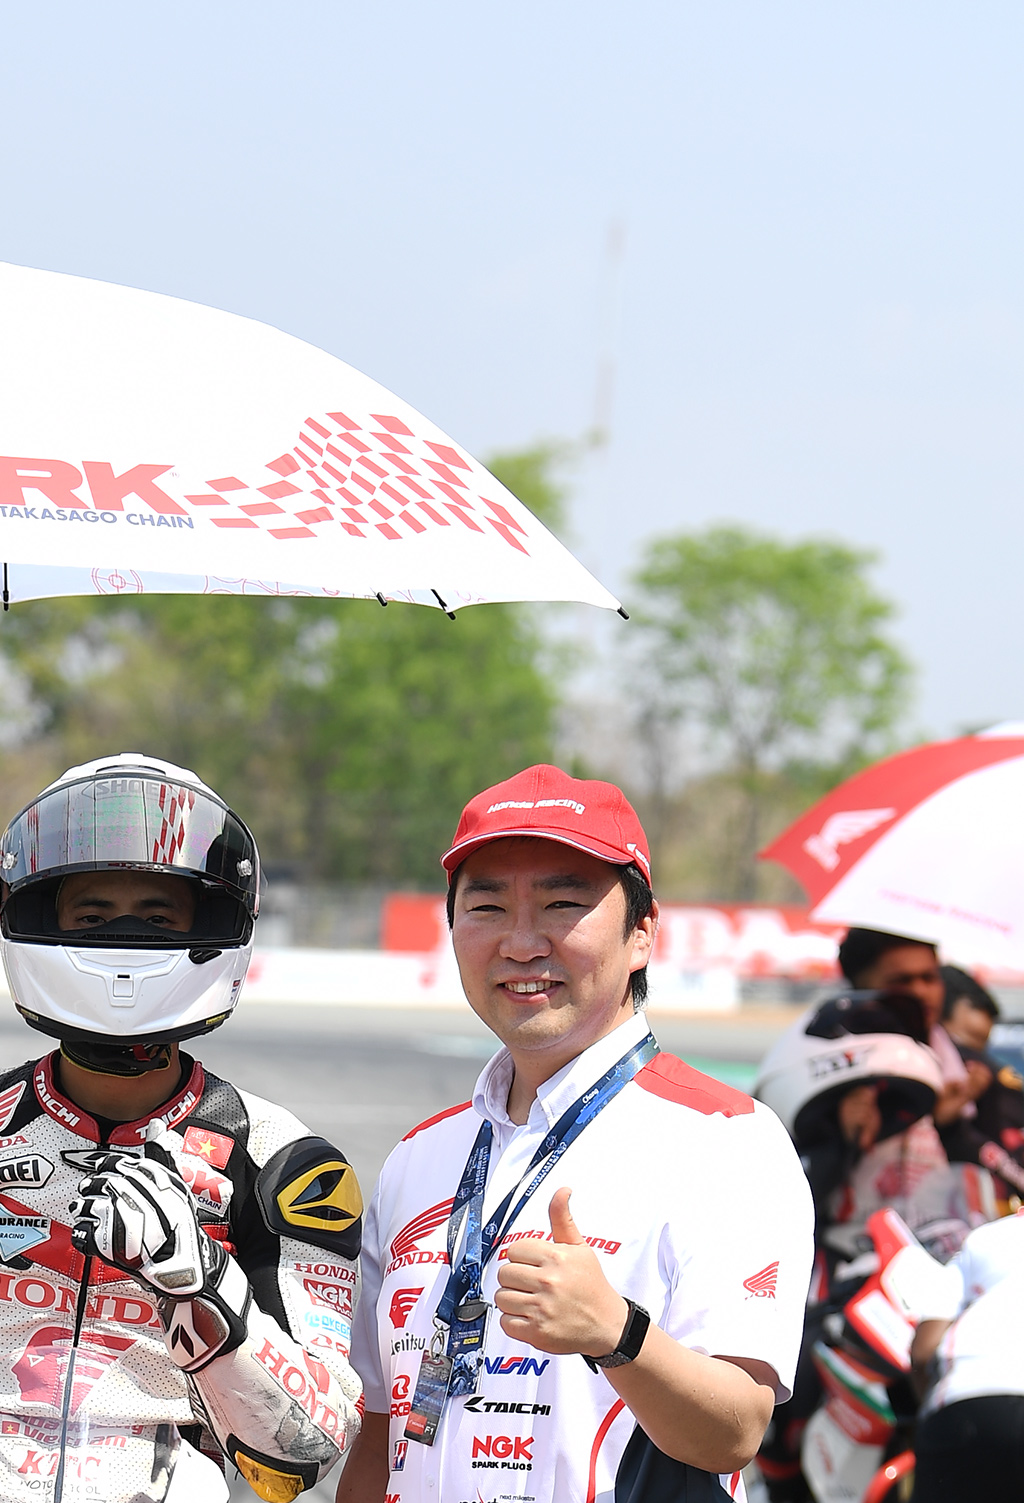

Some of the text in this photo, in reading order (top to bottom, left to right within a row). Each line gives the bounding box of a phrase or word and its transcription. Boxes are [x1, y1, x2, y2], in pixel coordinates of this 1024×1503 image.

[125, 514, 195, 530] CHAIN
[486, 798, 586, 815] Honda Racing
[35, 1070, 81, 1128] TAICHI
[197, 1196, 223, 1212] CHAIN
[0, 1232, 26, 1240] RACING
[293, 1262, 357, 1285] HONDA
[307, 1281, 352, 1309] NGK
[482, 1402, 552, 1416] TAICHI
[471, 1435, 535, 1461] NGK
[471, 1461, 533, 1471] SPARK PLUGS
